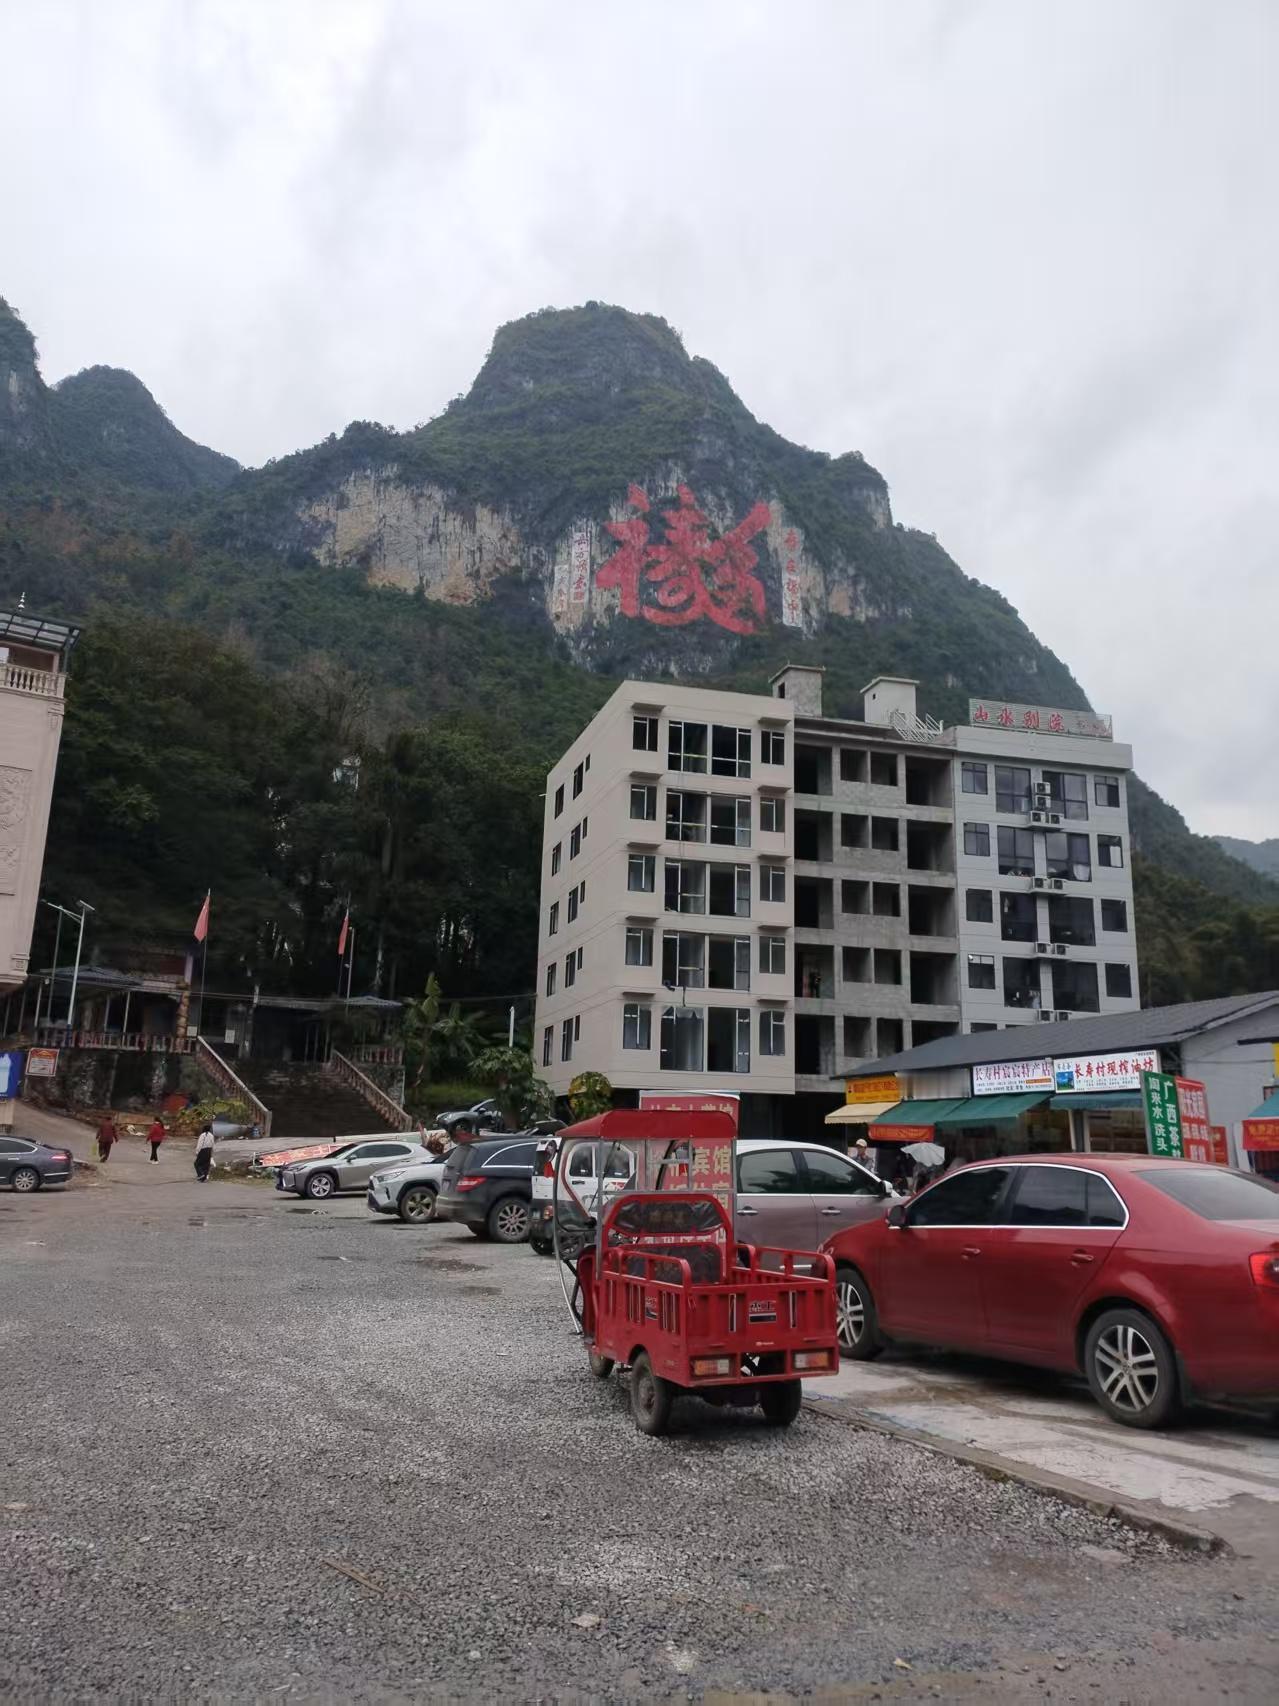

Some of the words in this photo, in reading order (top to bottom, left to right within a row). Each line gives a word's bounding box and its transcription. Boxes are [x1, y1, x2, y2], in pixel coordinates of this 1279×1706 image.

[973, 704, 1065, 732] 山水别院
[1075, 1057, 1154, 1079] 长寿村现榨油坊
